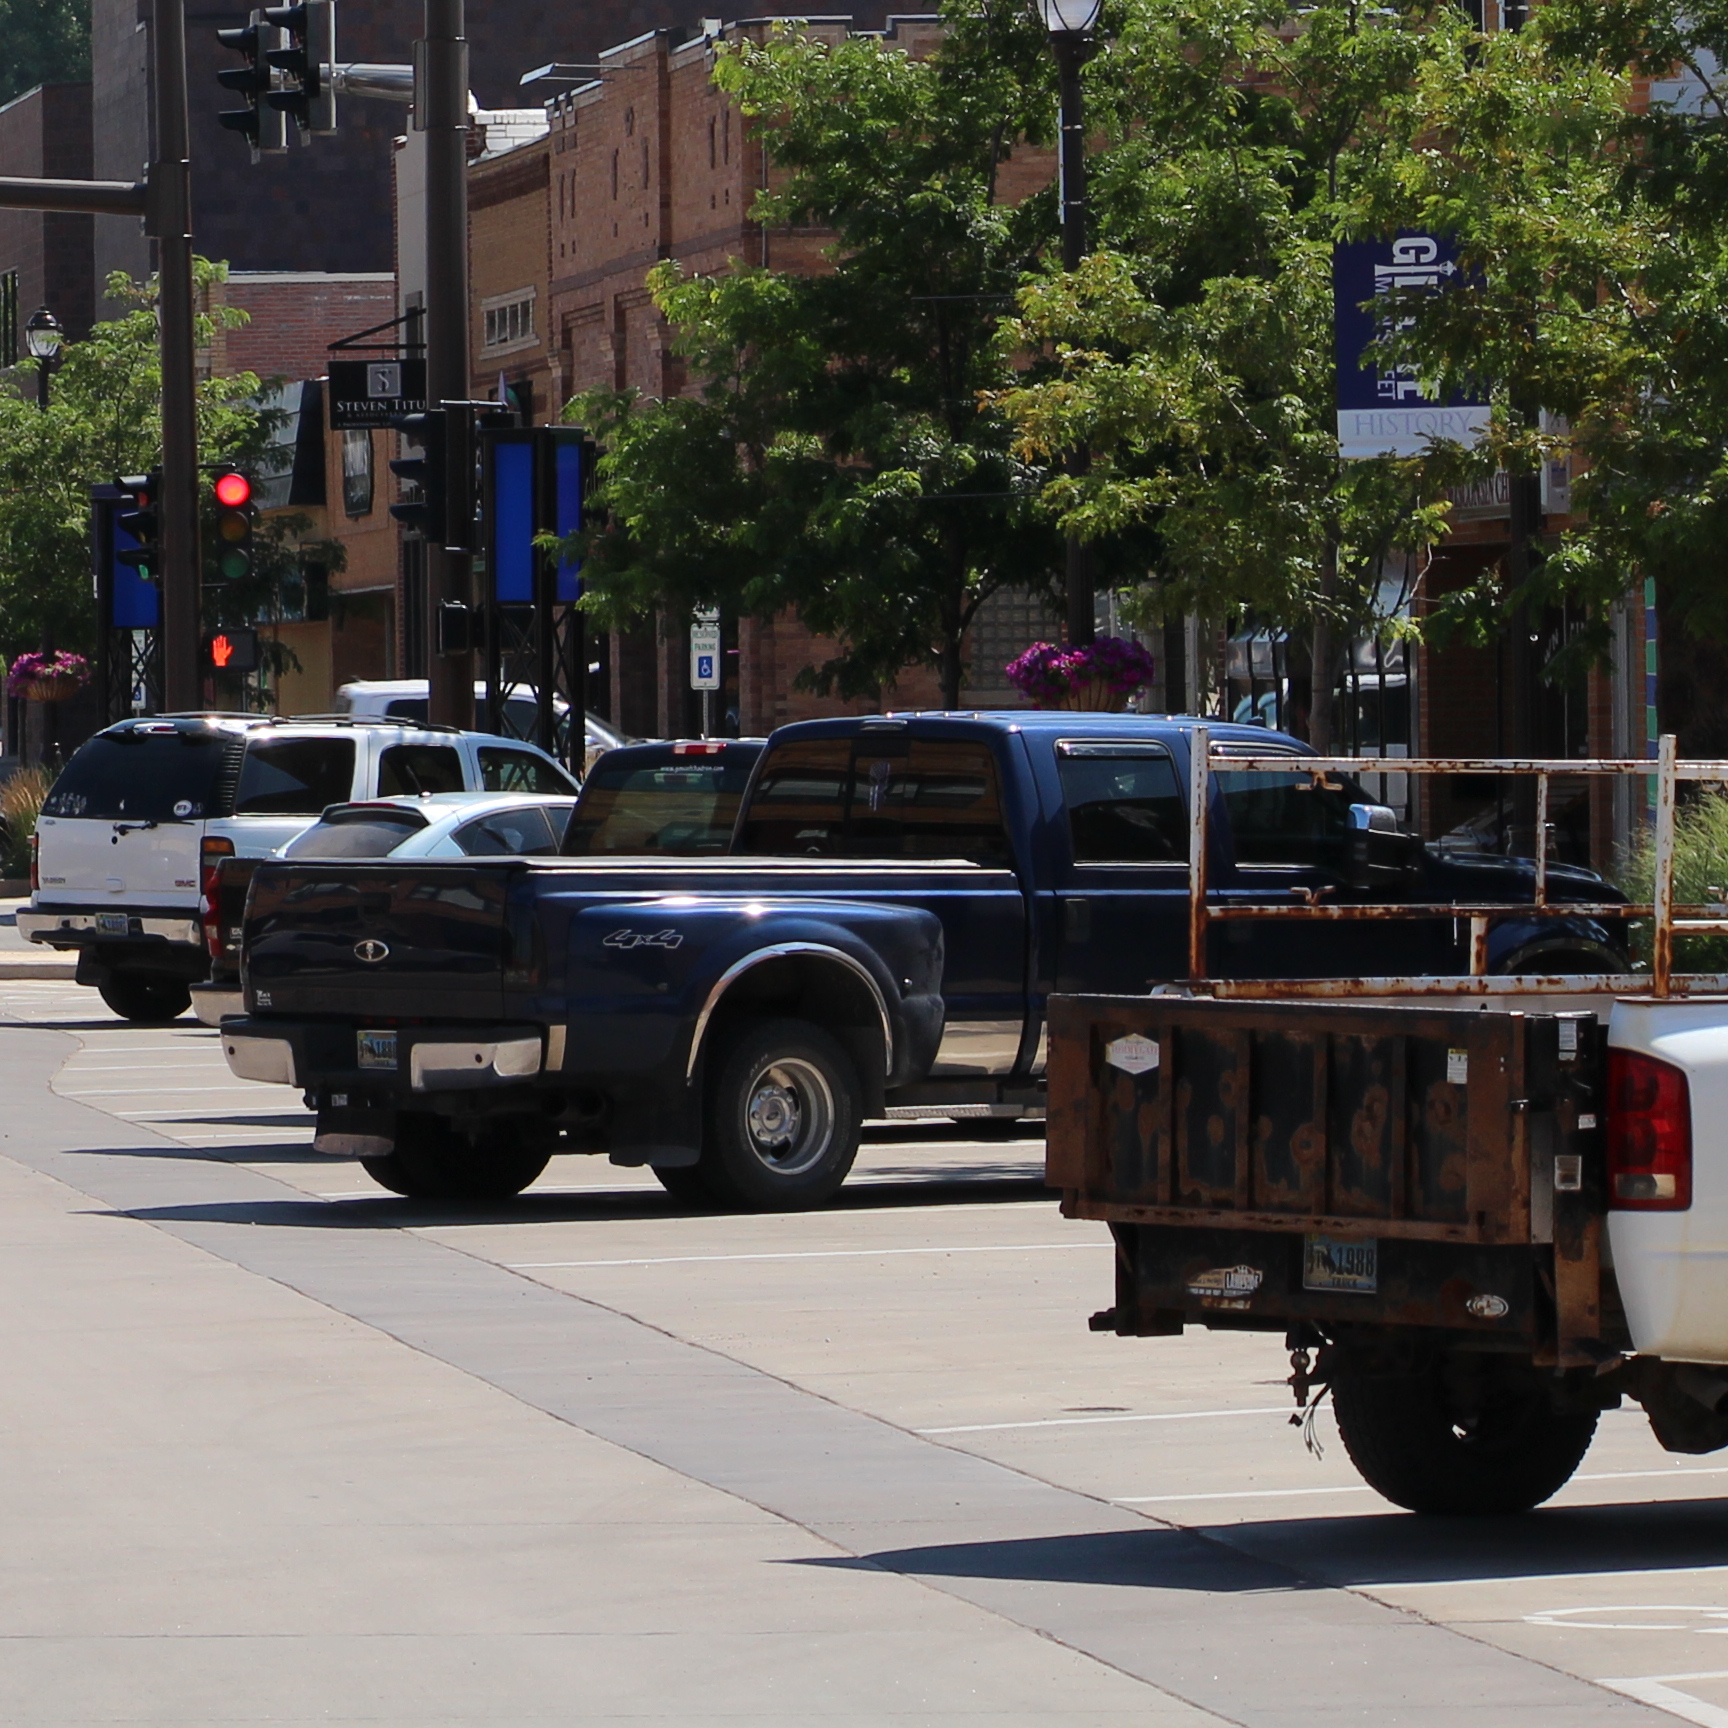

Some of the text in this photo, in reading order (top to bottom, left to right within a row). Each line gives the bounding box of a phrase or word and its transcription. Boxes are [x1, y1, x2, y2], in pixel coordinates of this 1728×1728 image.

[337, 401, 387, 412] STEVEN
[1355, 412, 1473, 436] HISTORY
[603, 929, 684, 949] 4x4
[1335, 1245, 1376, 1277] 1988
